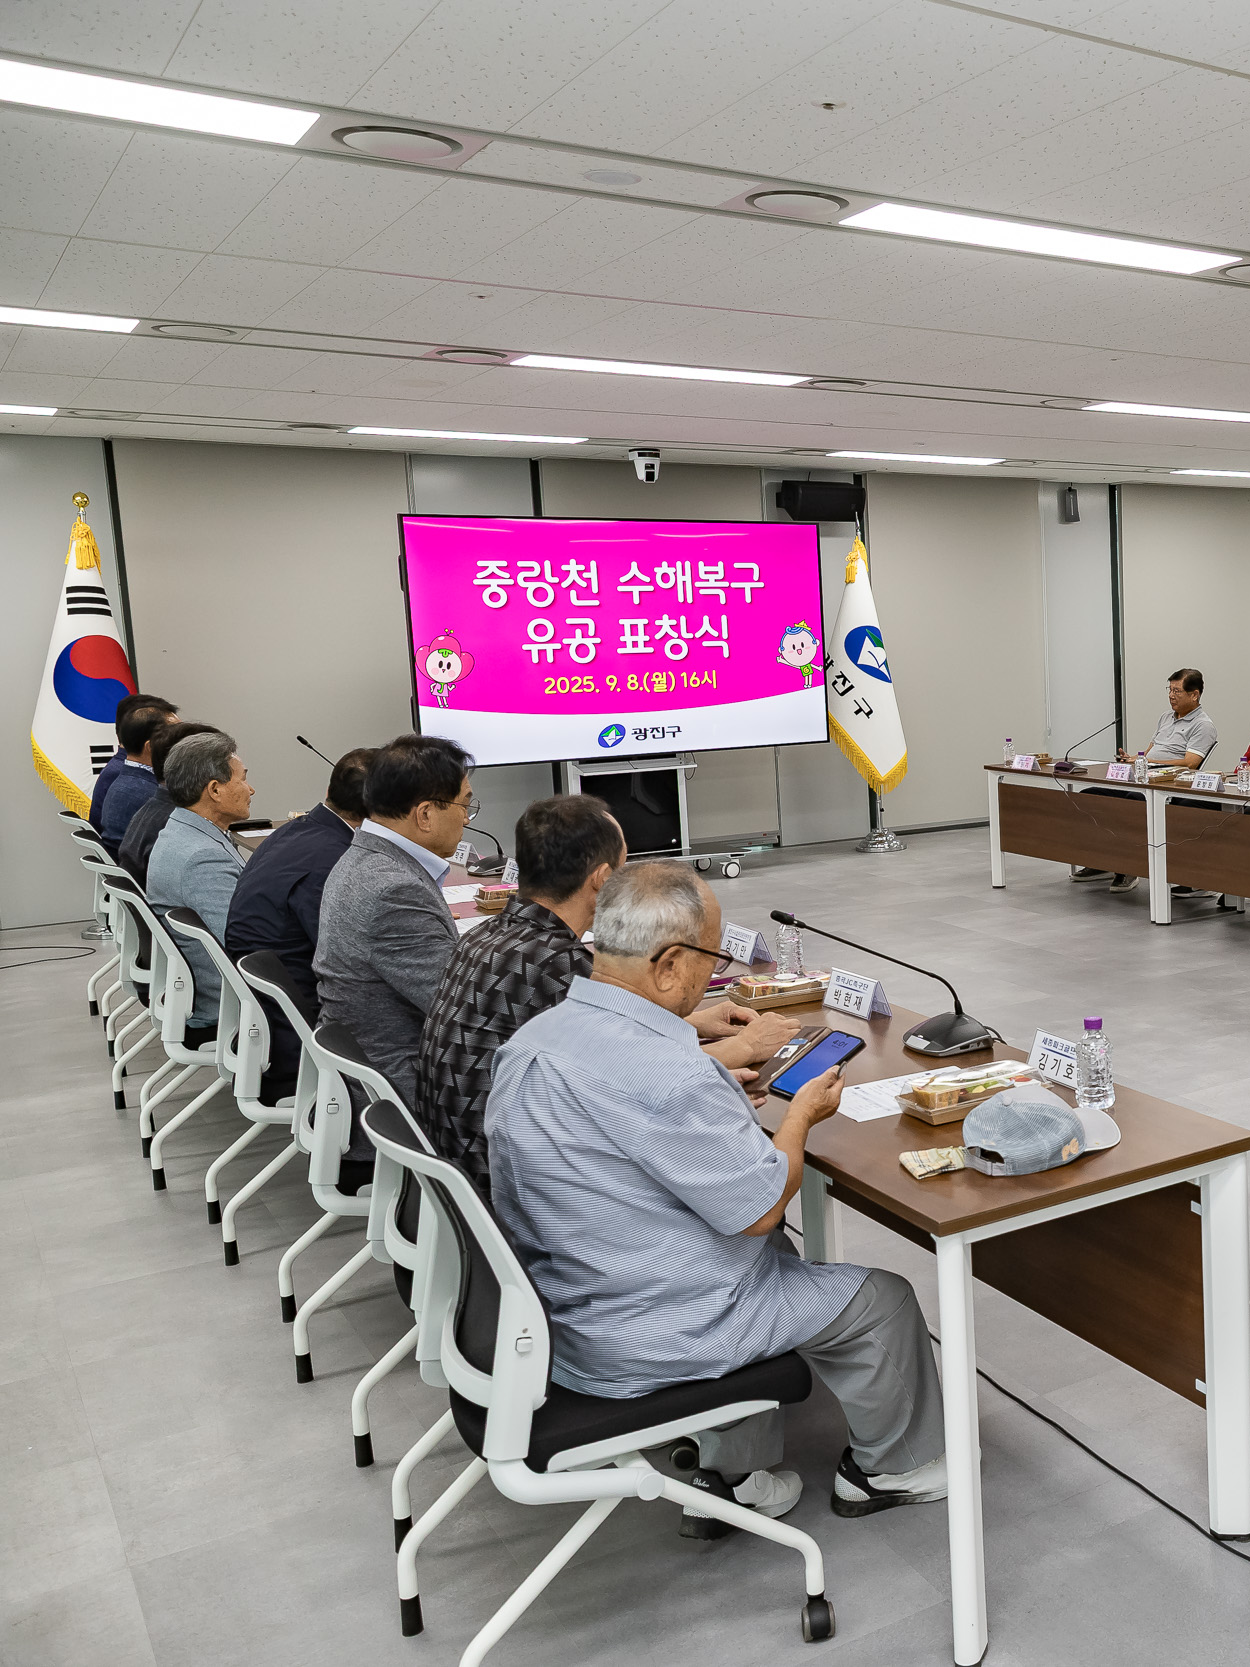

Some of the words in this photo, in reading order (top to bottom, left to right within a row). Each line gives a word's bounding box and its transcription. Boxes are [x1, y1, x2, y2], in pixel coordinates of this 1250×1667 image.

[473, 559, 600, 608] 중랑천
[616, 560, 764, 605] 수해복구
[522, 616, 601, 665] 유공
[616, 613, 730, 660] 표창식
[544, 675, 600, 695] 2025.
[606, 675, 622, 693] 9.
[626, 672, 676, 694] 8.(월)
[681, 669, 718, 690] 16시
[631, 725, 682, 741] 광진구
[833, 988, 864, 1012] 박현재
[1038, 1052, 1075, 1080] 김기호
